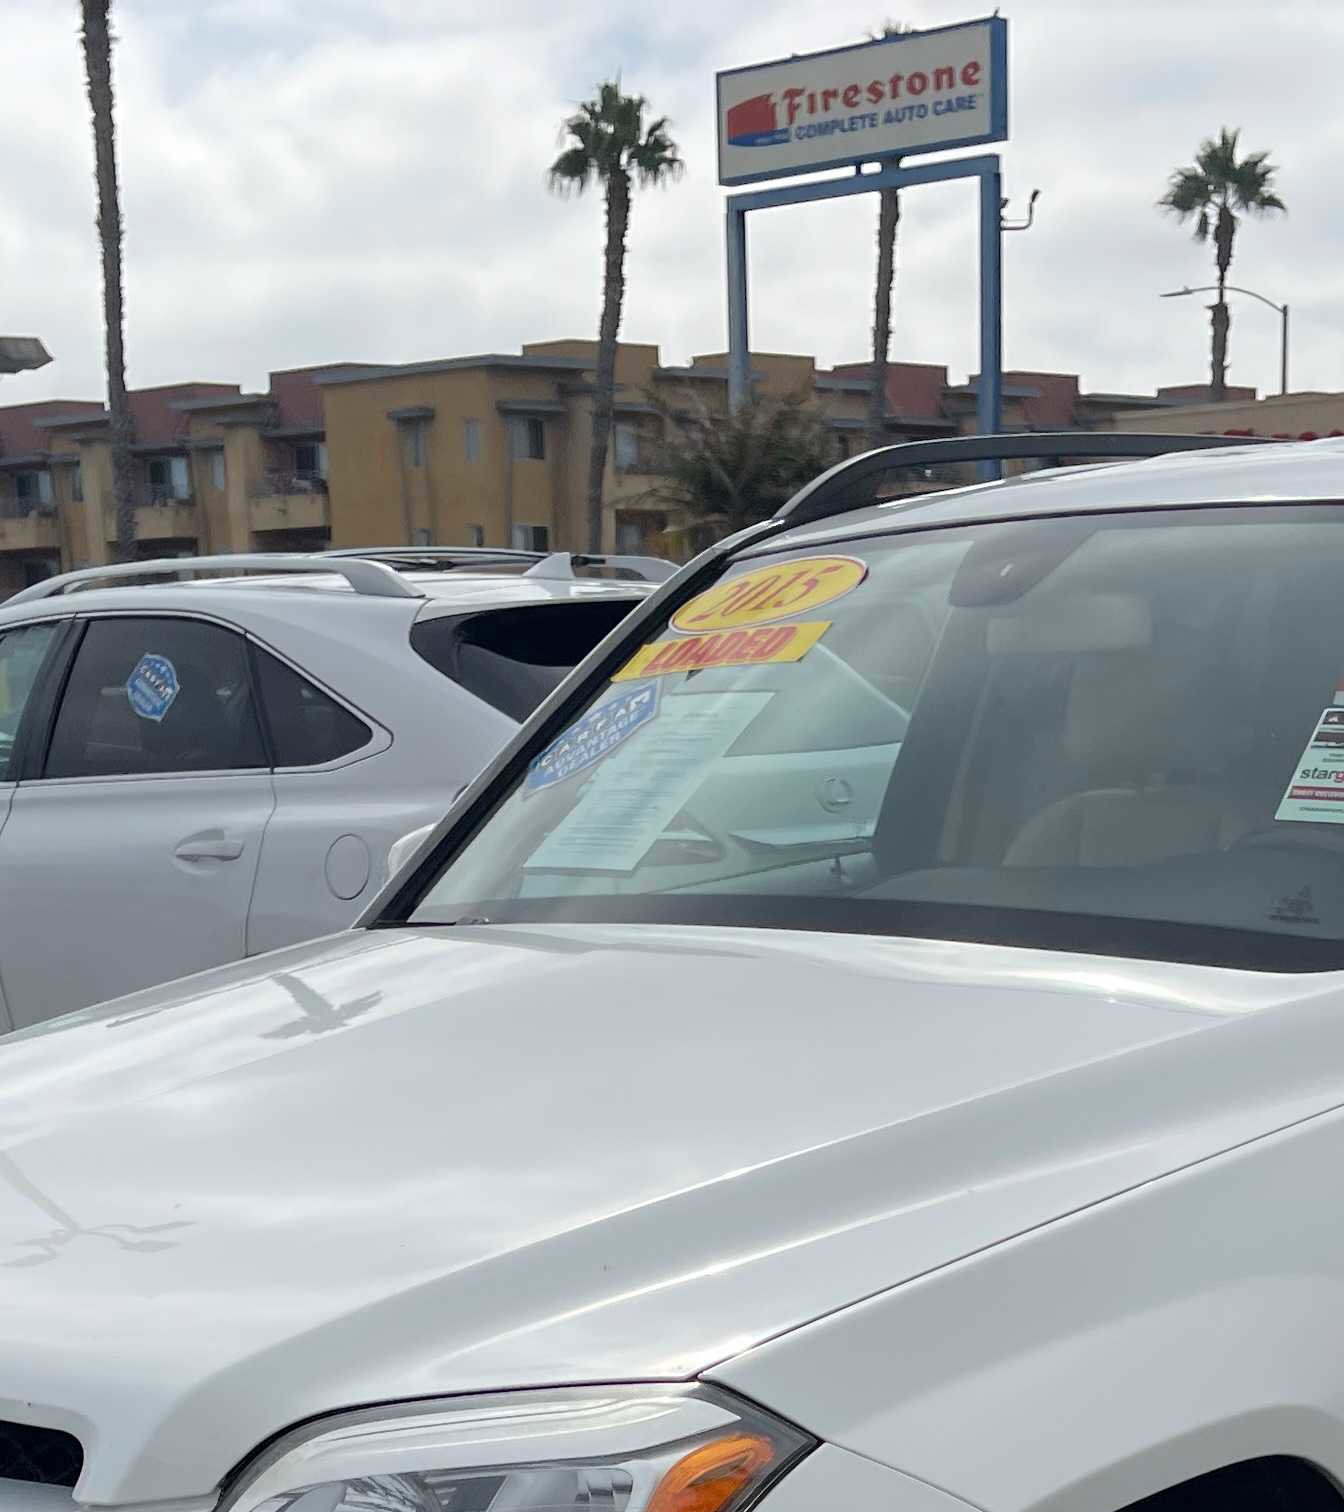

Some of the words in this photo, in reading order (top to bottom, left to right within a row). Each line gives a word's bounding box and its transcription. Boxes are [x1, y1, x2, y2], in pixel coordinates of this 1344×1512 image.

[782, 61, 981, 125] Firestone
[794, 113, 879, 141] COMPLETE
[883, 103, 929, 125] AUTO
[931, 94, 977, 117] CARE
[686, 565, 844, 624] 2015
[640, 626, 798, 675] LOADED
